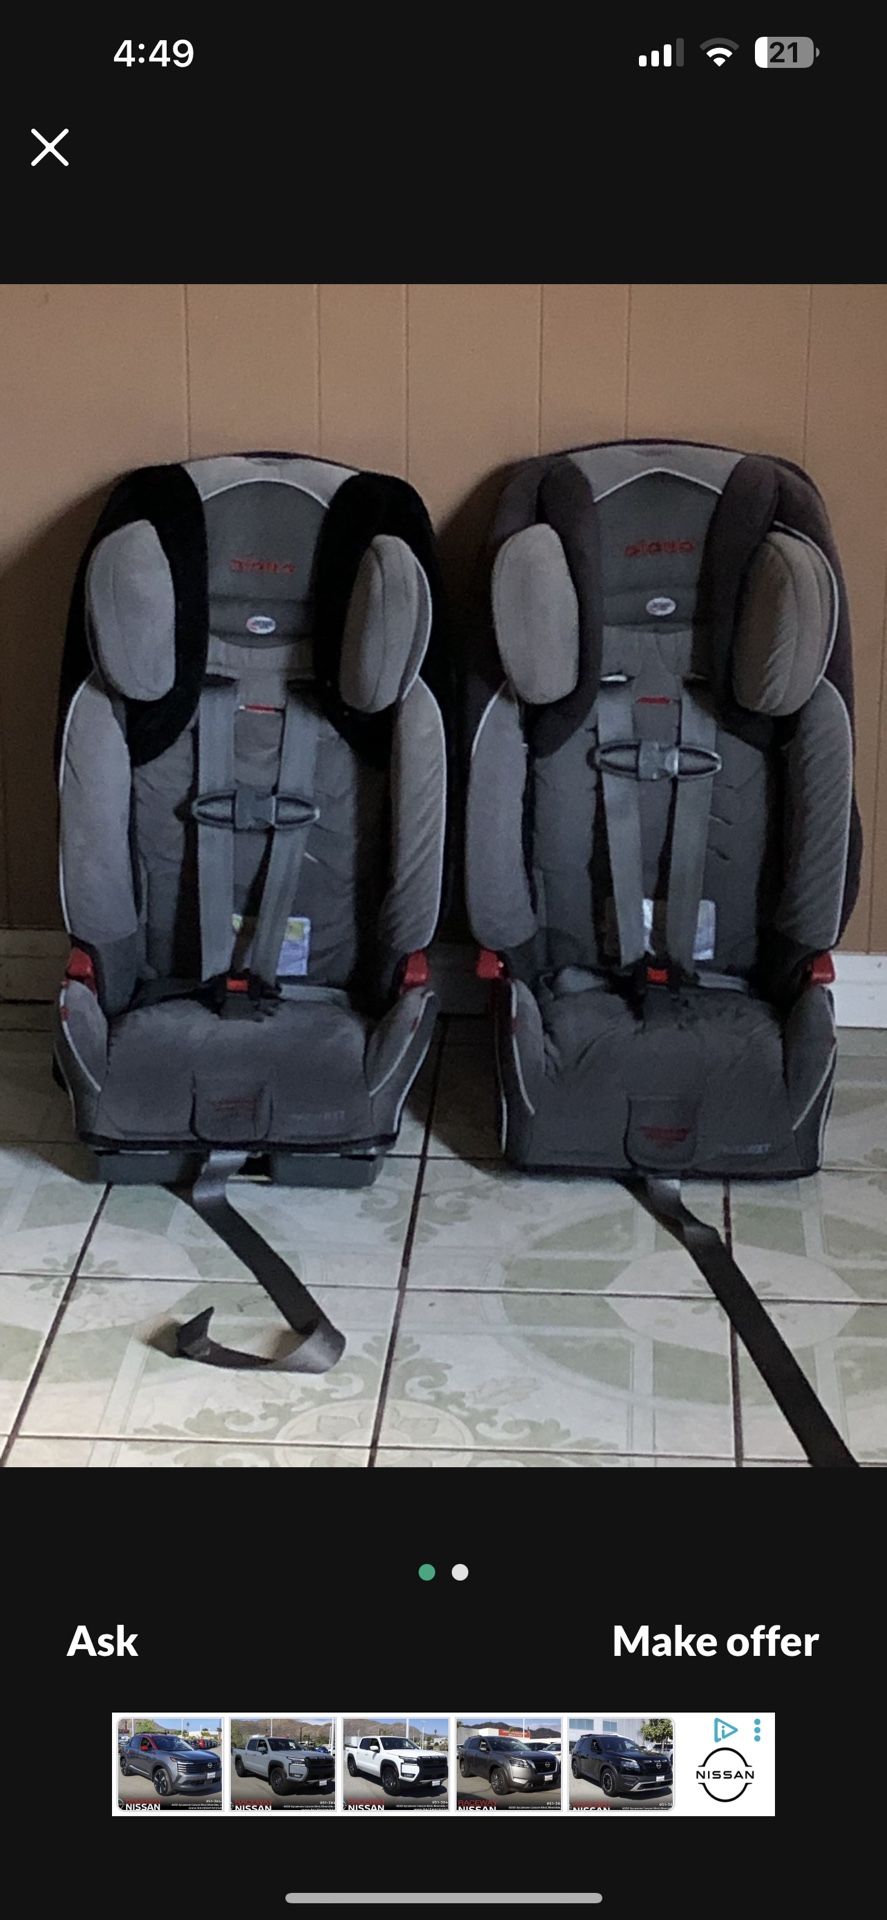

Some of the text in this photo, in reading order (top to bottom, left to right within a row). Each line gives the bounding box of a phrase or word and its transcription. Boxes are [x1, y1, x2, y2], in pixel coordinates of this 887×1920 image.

[113, 38, 195, 68] 4:49
[769, 41, 798, 63] 21
[65, 1624, 139, 1657] Ask
[613, 1624, 820, 1657] Make offer
[695, 1770, 755, 1780] NISSAN
[125, 1803, 161, 1811] NISSAN
